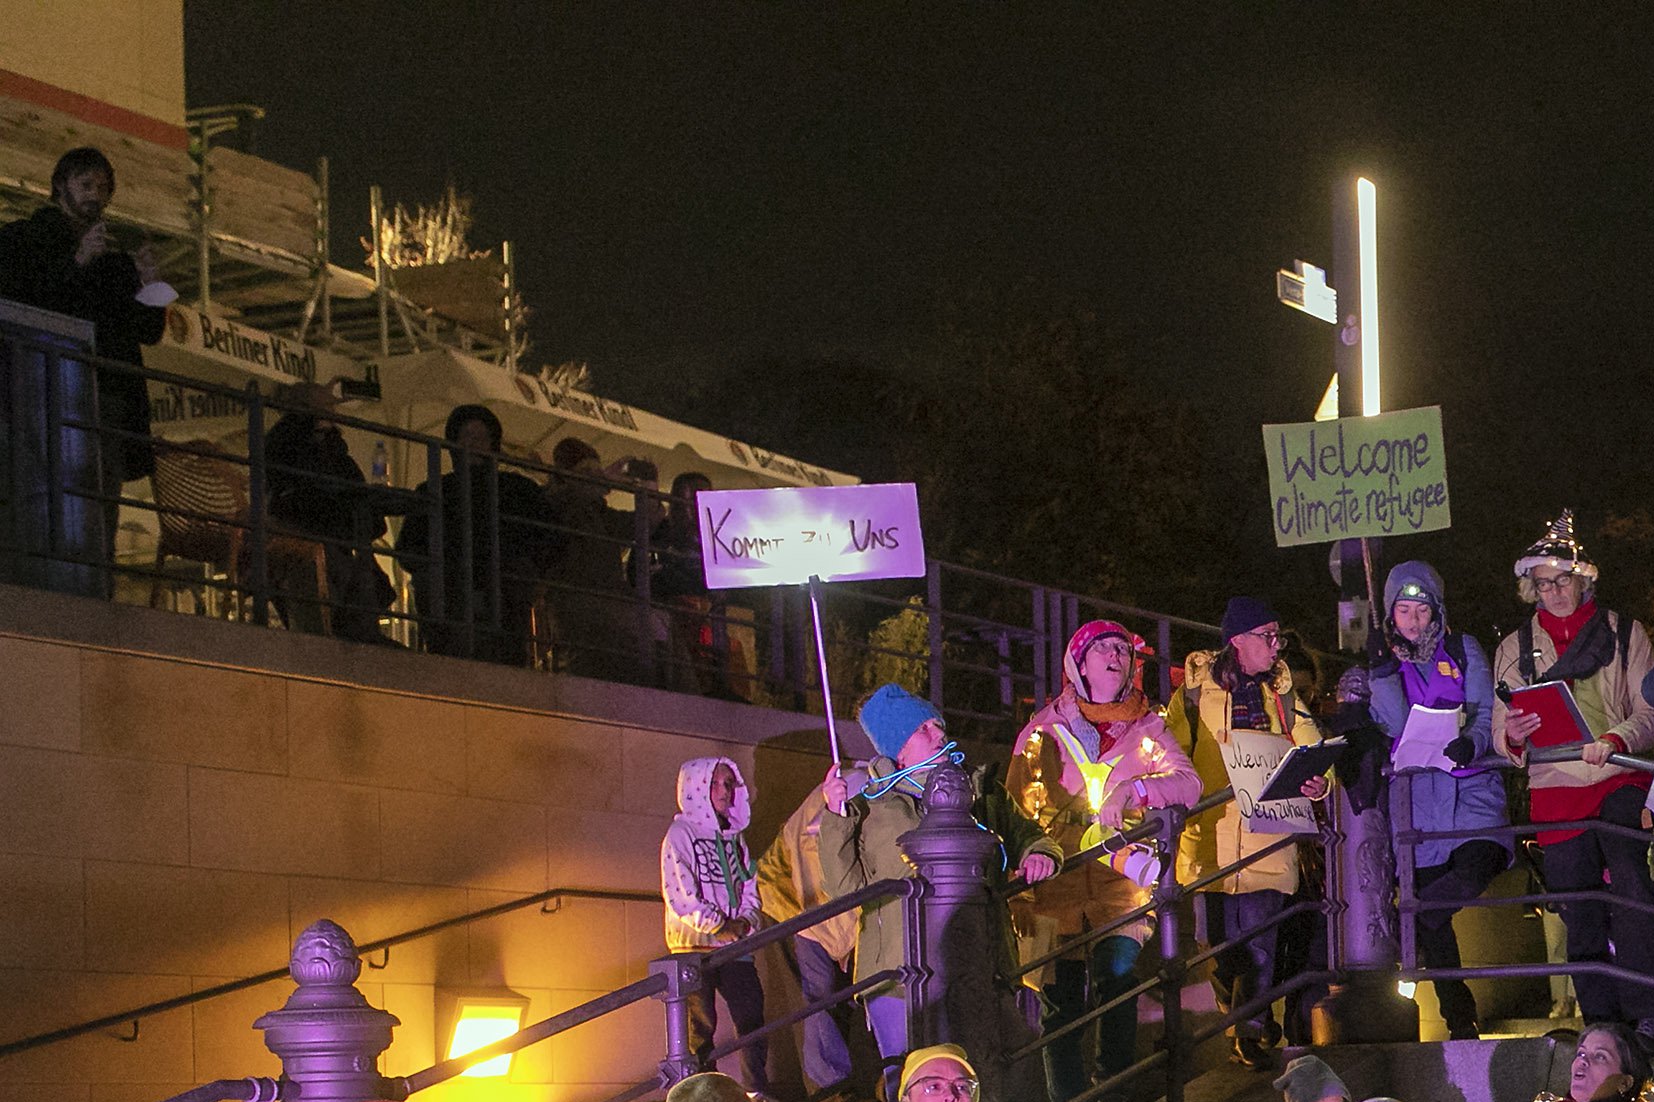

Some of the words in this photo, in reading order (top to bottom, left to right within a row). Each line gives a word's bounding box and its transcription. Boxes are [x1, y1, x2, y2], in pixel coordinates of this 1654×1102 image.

[199, 312, 268, 367] Berliner
[269, 335, 316, 384] Kindl
[1280, 424, 1431, 483] Welcome
[1365, 472, 1446, 533] refugee
[849, 519, 900, 553] UNS
[1229, 742, 1268, 769] Mein
[1238, 788, 1277, 821] Dein
